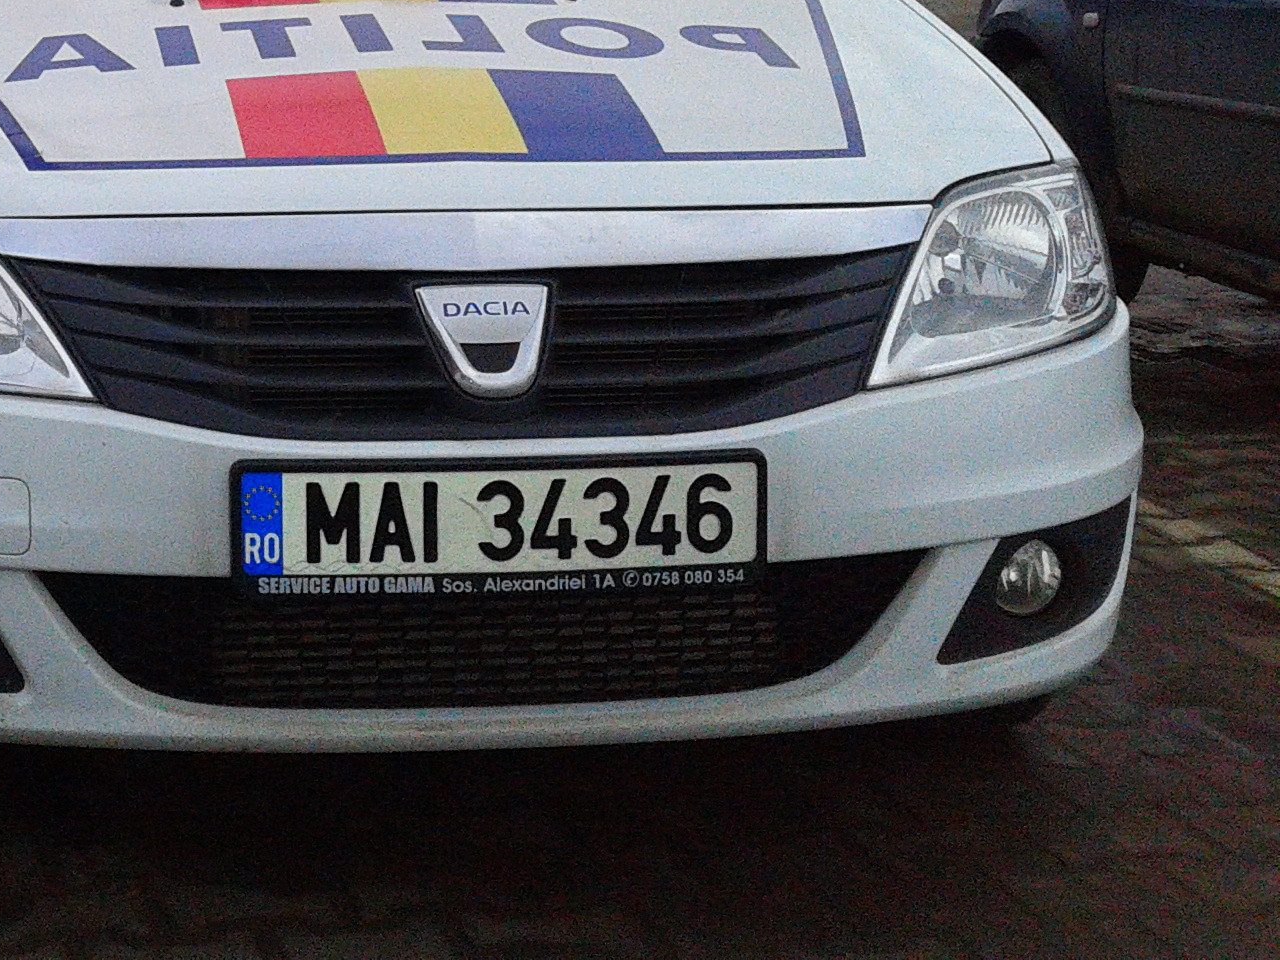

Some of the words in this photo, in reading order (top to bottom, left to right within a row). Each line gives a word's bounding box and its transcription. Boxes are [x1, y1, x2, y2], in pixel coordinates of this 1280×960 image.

[442, 301, 531, 317] DACIA
[305, 480, 439, 565] MAI
[476, 472, 734, 563] 34346
[244, 531, 280, 566] RO
[257, 576, 331, 594] SERVICE
[333, 576, 380, 594] AUTO
[383, 576, 436, 594] GAMA
[442, 577, 478, 593] Sos.
[593, 573, 616, 590] 1A
[684, 570, 713, 585] 080
[717, 568, 745, 584] 354
